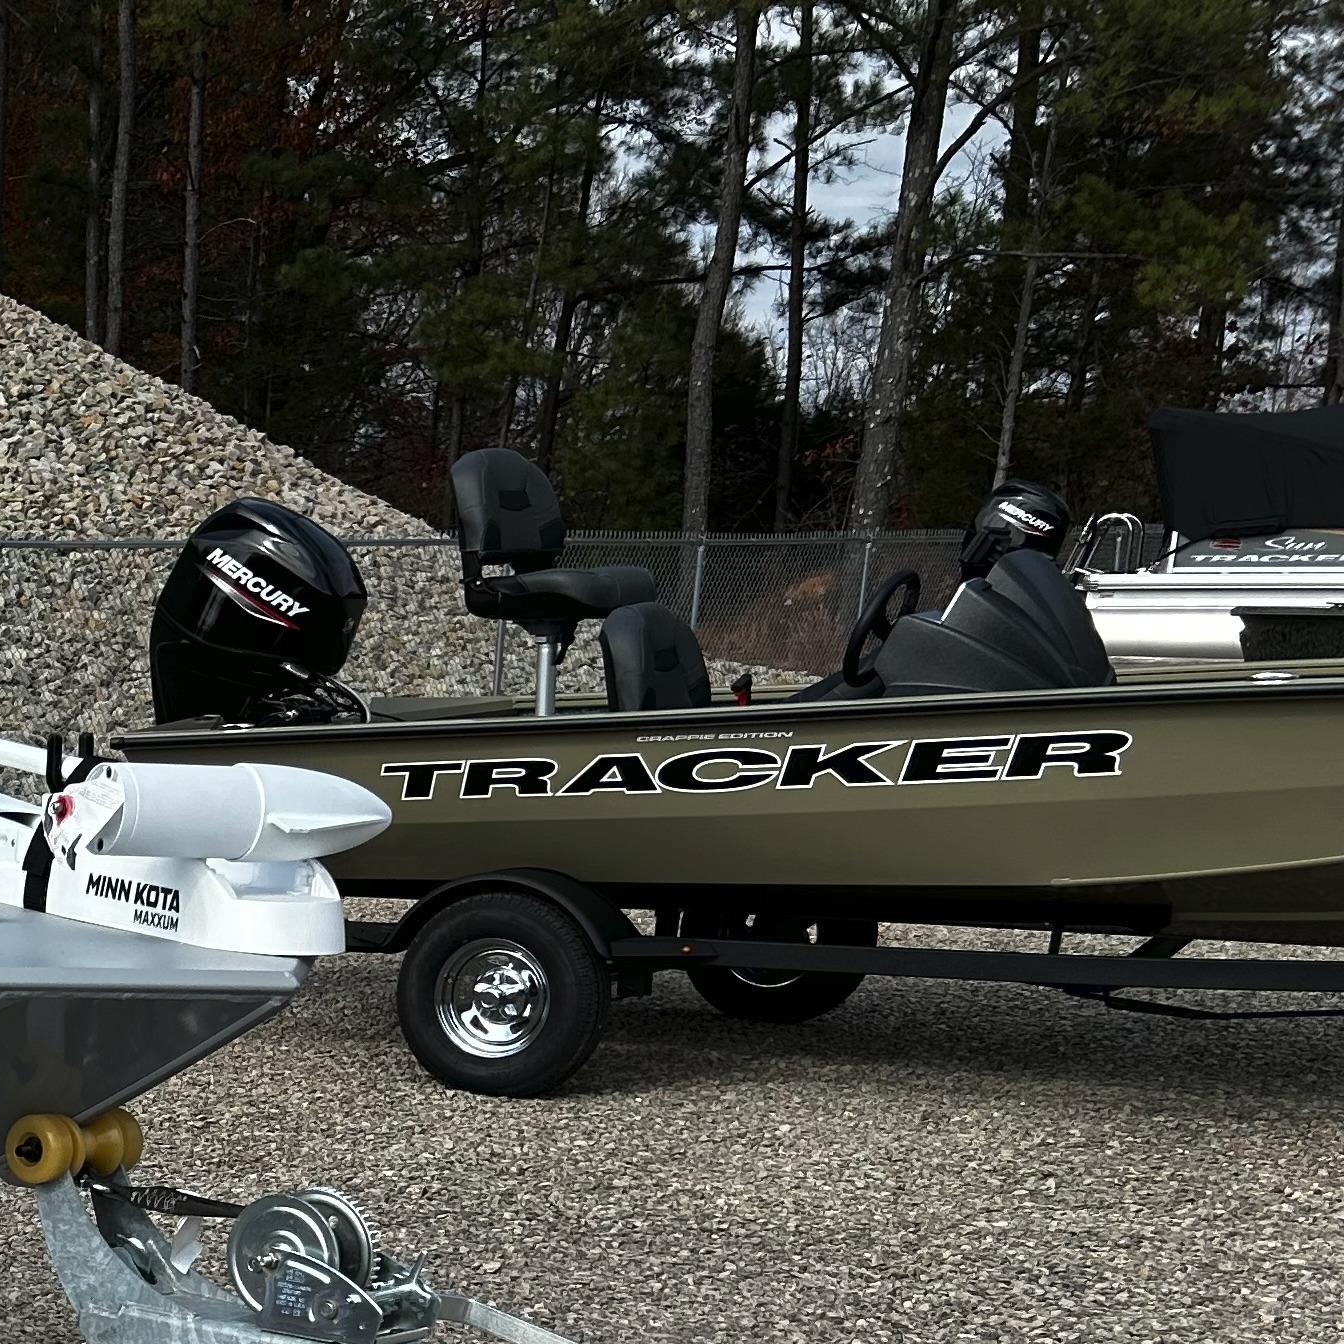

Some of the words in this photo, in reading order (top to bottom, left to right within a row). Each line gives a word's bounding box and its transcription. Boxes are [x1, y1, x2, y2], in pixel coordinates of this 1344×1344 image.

[1265, 536, 1326, 550] Sun
[206, 548, 310, 616] MERCURY
[636, 733, 715, 742] CRAPPIE
[718, 731, 794, 740] EDITION
[381, 730, 1133, 800] TRACKER
[86, 873, 132, 902] MINN
[134, 882, 180, 913] KOTA
[133, 909, 179, 932] MAXXUM
